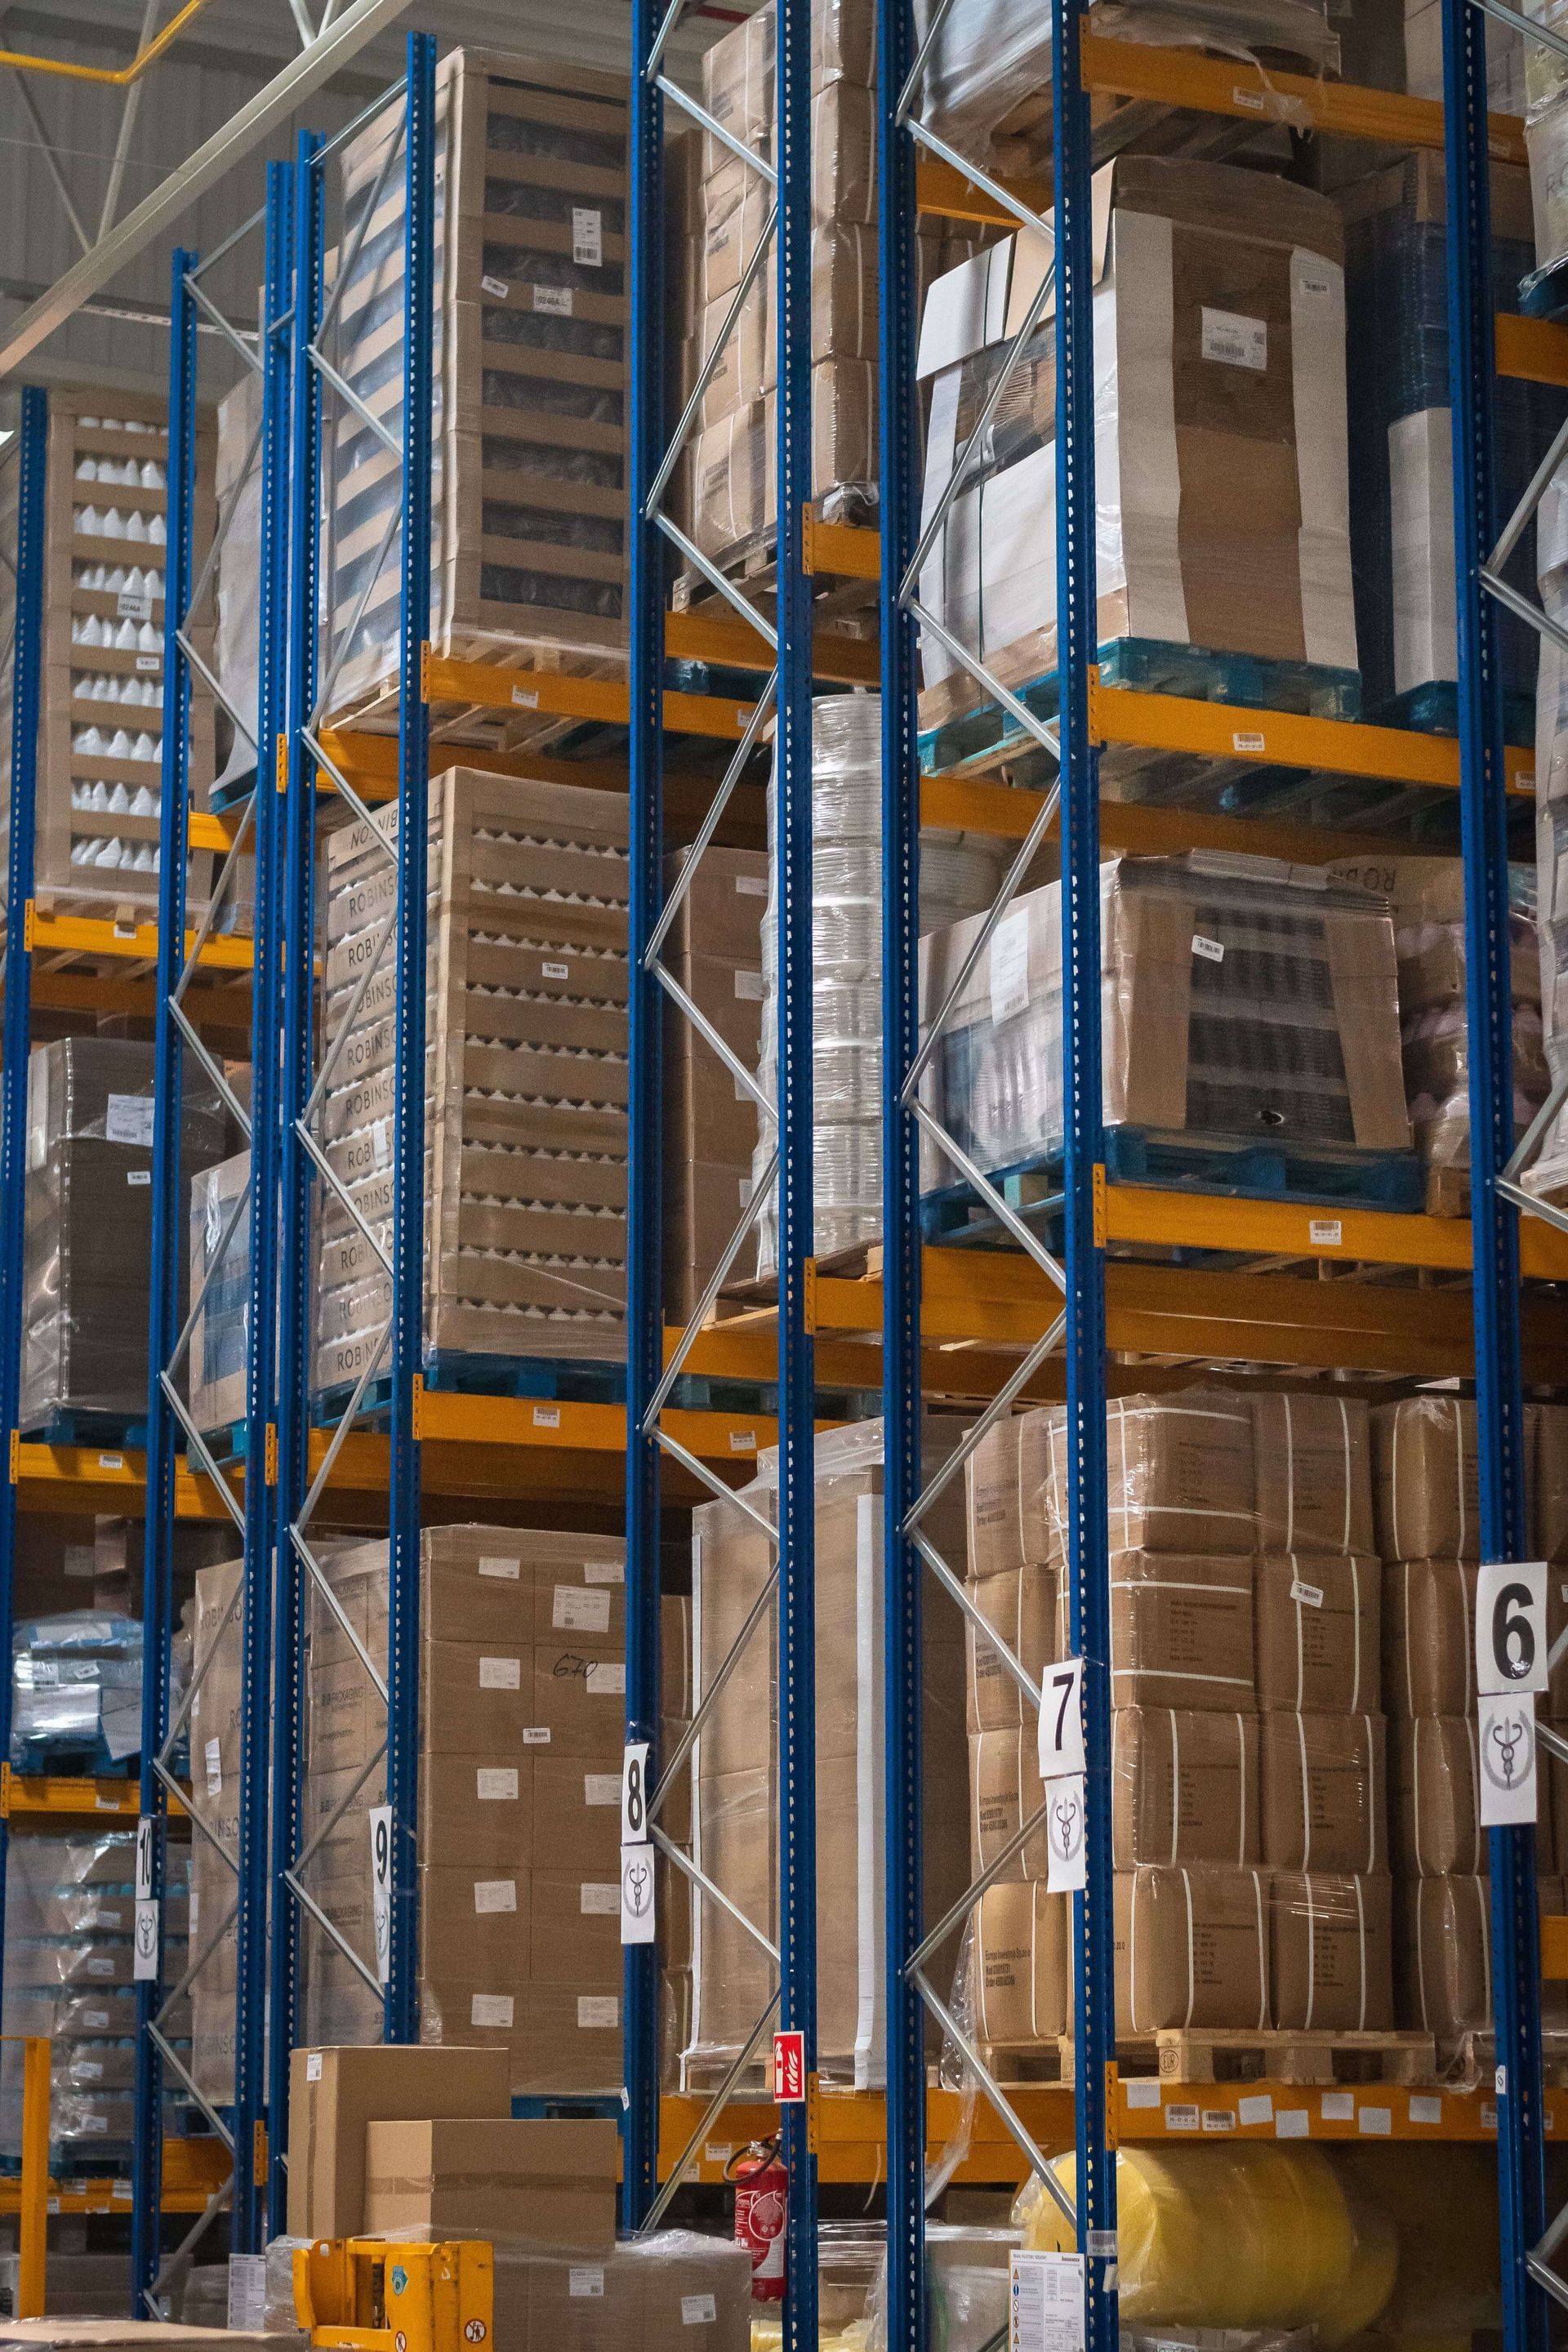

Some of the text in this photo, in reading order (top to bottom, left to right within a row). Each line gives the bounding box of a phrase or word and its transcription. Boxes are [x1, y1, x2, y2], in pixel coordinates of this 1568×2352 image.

[349, 873, 399, 918] ROBINS
[357, 973, 398, 1014] OBINSO
[336, 1337, 390, 1372] ROBIN
[1493, 1583, 1535, 1680] 6
[553, 1654, 599, 1678] 670
[1052, 1672, 1075, 1751] 7
[628, 1759, 643, 1832] 8
[140, 1827, 151, 1886] 10
[376, 1820, 388, 1885] 9
[1163, 2053, 1175, 2069] EUR
